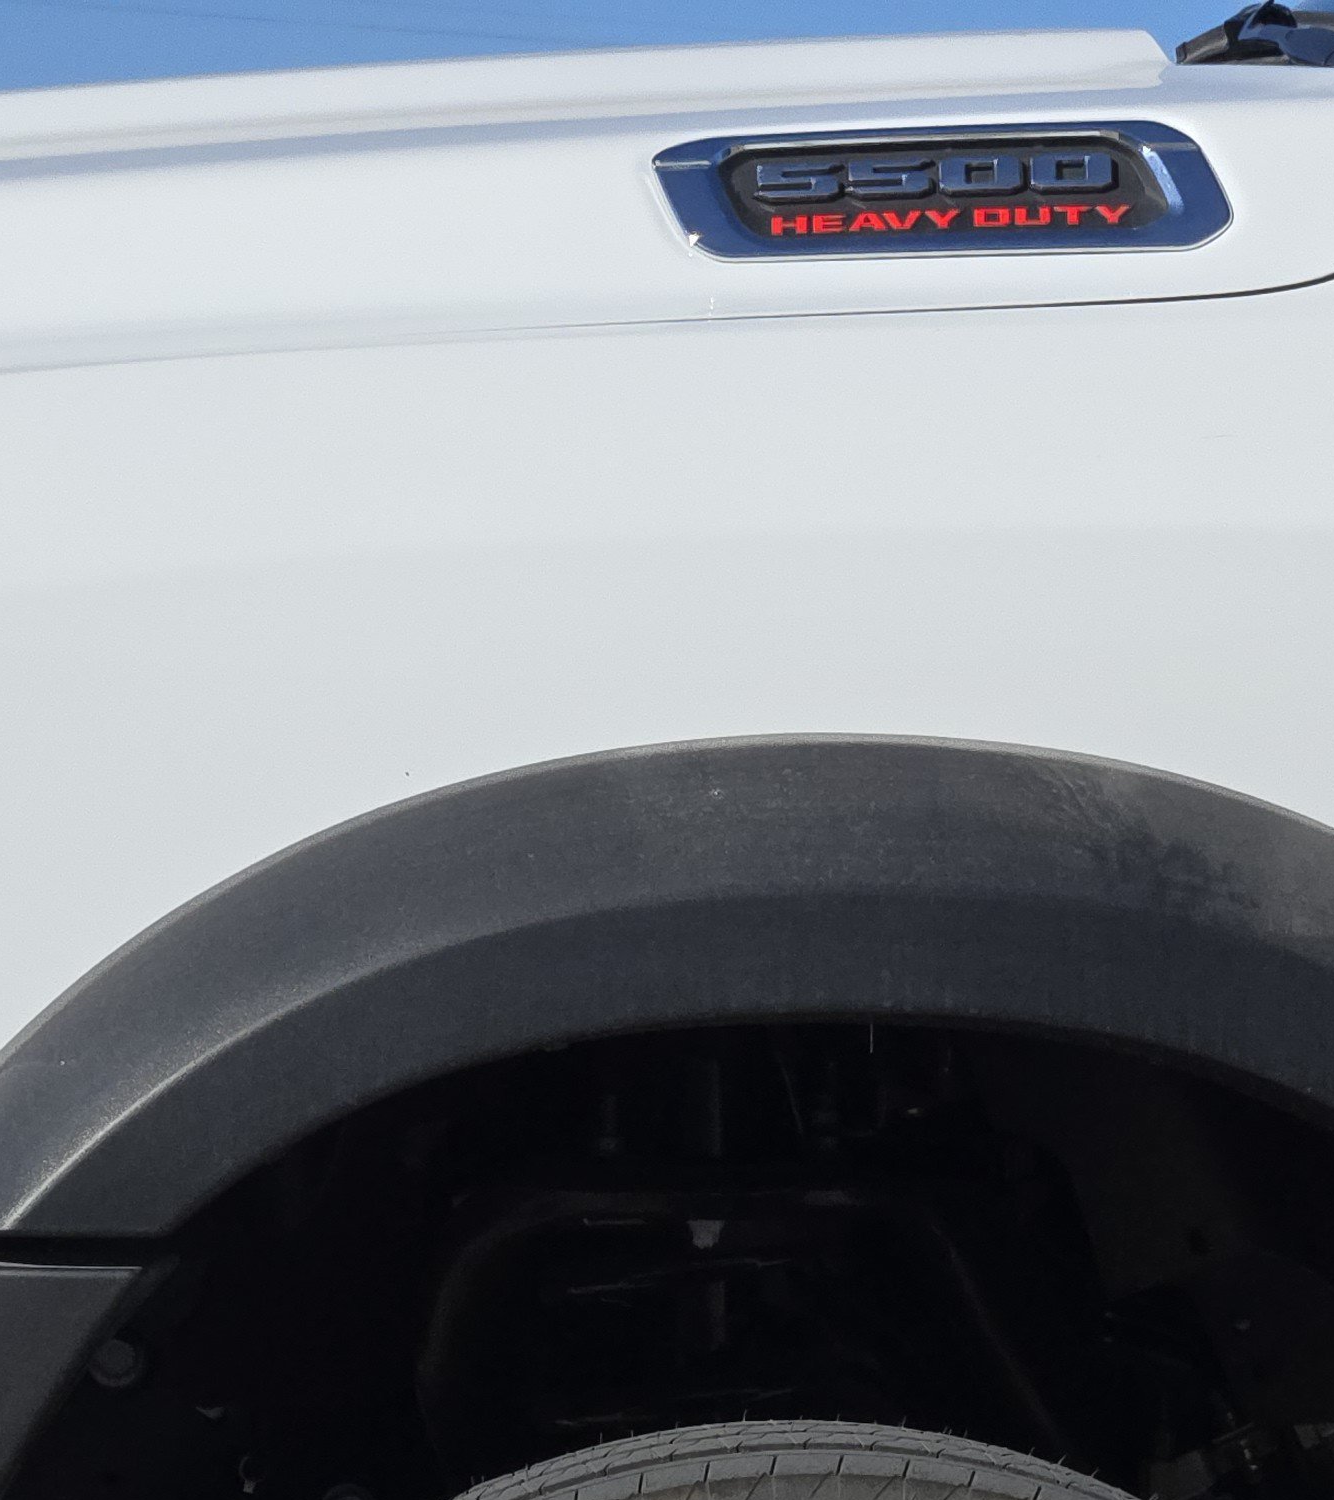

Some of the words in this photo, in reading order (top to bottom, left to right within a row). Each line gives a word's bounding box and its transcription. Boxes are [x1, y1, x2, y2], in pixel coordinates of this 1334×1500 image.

[756, 151, 1116, 201] 5500
[770, 209, 961, 236] HEAVY
[972, 204, 1130, 228] DUTY
